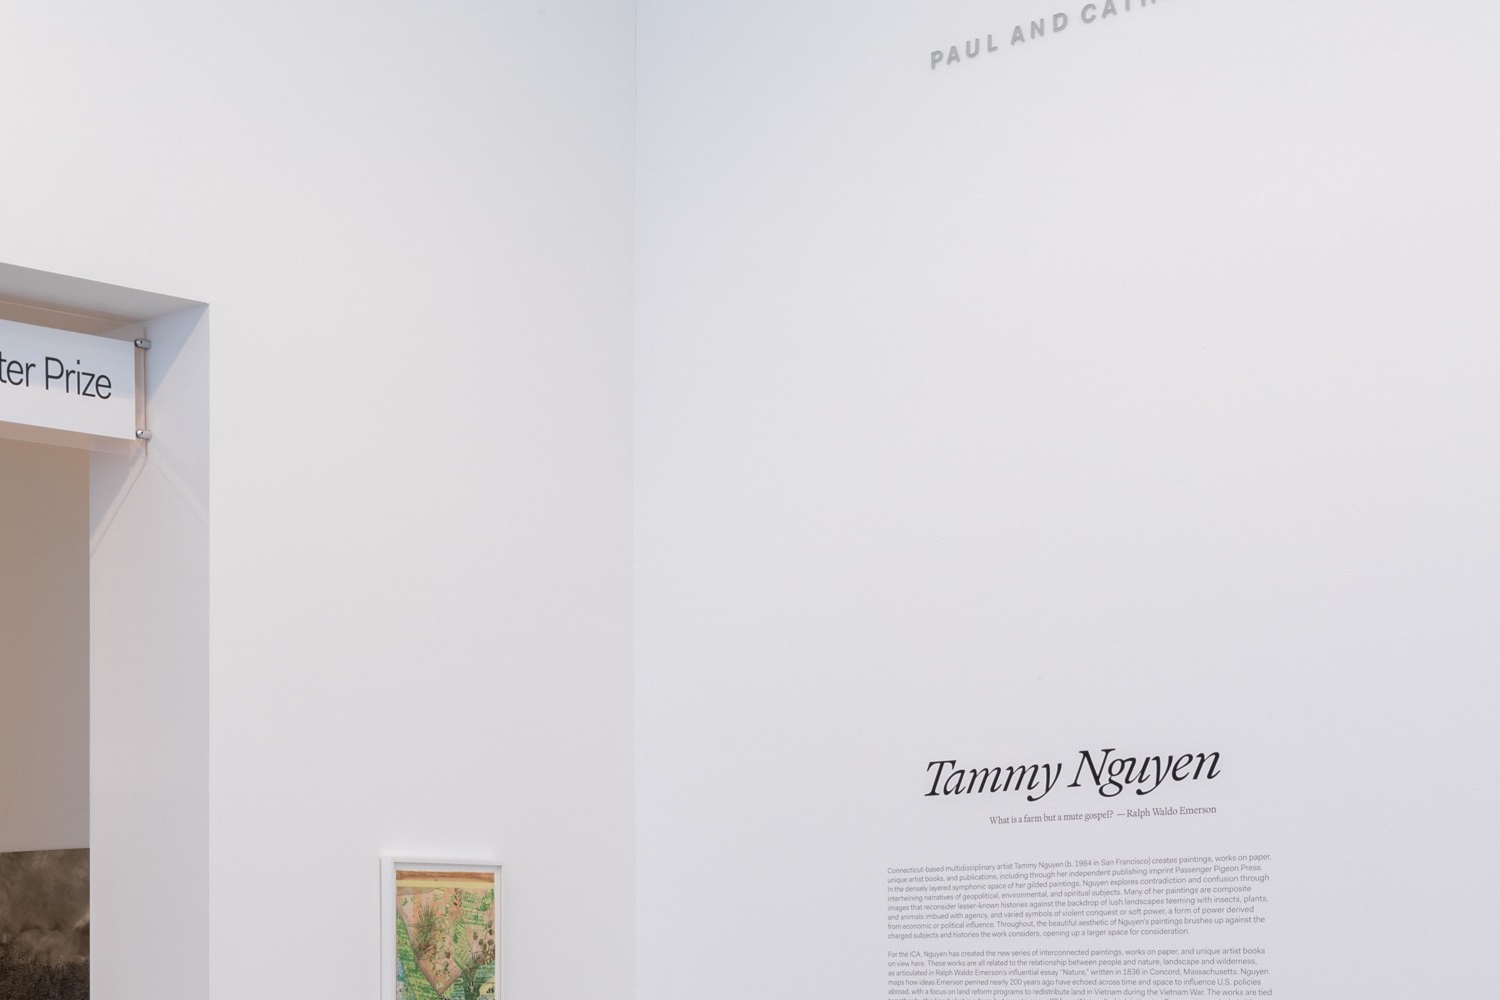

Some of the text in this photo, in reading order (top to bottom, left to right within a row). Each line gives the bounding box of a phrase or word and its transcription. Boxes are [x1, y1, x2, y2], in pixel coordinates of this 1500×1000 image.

[930, 34, 998, 70] PAUL
[1010, 12, 1069, 46] AND
[45, 356, 112, 400] Prize
[924, 748, 1222, 802] Tammy Nguyen
[989, 816, 1010, 824] What
[1011, 816, 1017, 824] is
[1023, 814, 1041, 823] farm
[1043, 813, 1056, 822] but
[1063, 813, 1083, 821] mute
[1084, 810, 1114, 822] gospel?
[1152, 806, 1178, 816] Waldo
[1179, 806, 1217, 815] Emerson
[887, 864, 944, 874] Connecticut-based
[945, 863, 996, 872] multidisciplinary
[996, 862, 1013, 870] artist
[1014, 861, 1037, 870] Tammy
[1038, 860, 1064, 870] Nguyen
[1075, 859, 1092, 867] 1984
[887, 875, 908, 884] unique
[909, 874, 924, 882] artist
[946, 873, 958, 881] and
[1000, 871, 1029, 880] including
[1029, 870, 1056, 879] through
[1069, 869, 1111, 878] independent
[1112, 868, 1148, 876] publishing
[1149, 867, 1174, 875] imprint
[1175, 866, 1212, 875] Passenger
[1214, 865, 1239, 874] Pigeon
[905, 884, 928, 892] densely
[929, 883, 951, 891] layered
[952, 882, 986, 891] symphonic
[1027, 881, 1048, 889] gilded
[1083, 879, 1109, 887] Nguyen
[1110, 878, 1139, 887] explores
[1140, 877, 1187, 885] contradiction
[1240, 875, 1270, 883] through
[888, 893, 923, 903] intertwining
[924, 893, 954, 901] narratives
[1064, 889, 1090, 898] spiritual
[1124, 888, 1143, 896] Many
[1166, 887, 1199, 895] paintings
[1213, 886, 1252, 894] composite
[888, 903, 910, 912] images
[924, 902, 956, 910] reconsider
[958, 901, 999, 909] lesser-known
[1029, 900, 1054, 908] against
[1067, 899, 1099, 907] backdrop
[1125, 898, 1165, 906] landscapes
[1166, 897, 1196, 906] teeming
[888, 922, 902, 930] from
[903, 921, 932, 929] economic
[941, 921, 965, 929] political
[1049, 919, 1077, 927] beautiful
[1150, 917, 1183, 926] paintings
[1225, 916, 1252, 925] against
[888, 931, 912, 940] charged
[913, 931, 939, 939] subjects
[953, 930, 980, 938] histories
[980, 930, 991, 938] the
[1043, 929, 1070, 938] opening
[1087, 929, 1106, 937] larger
